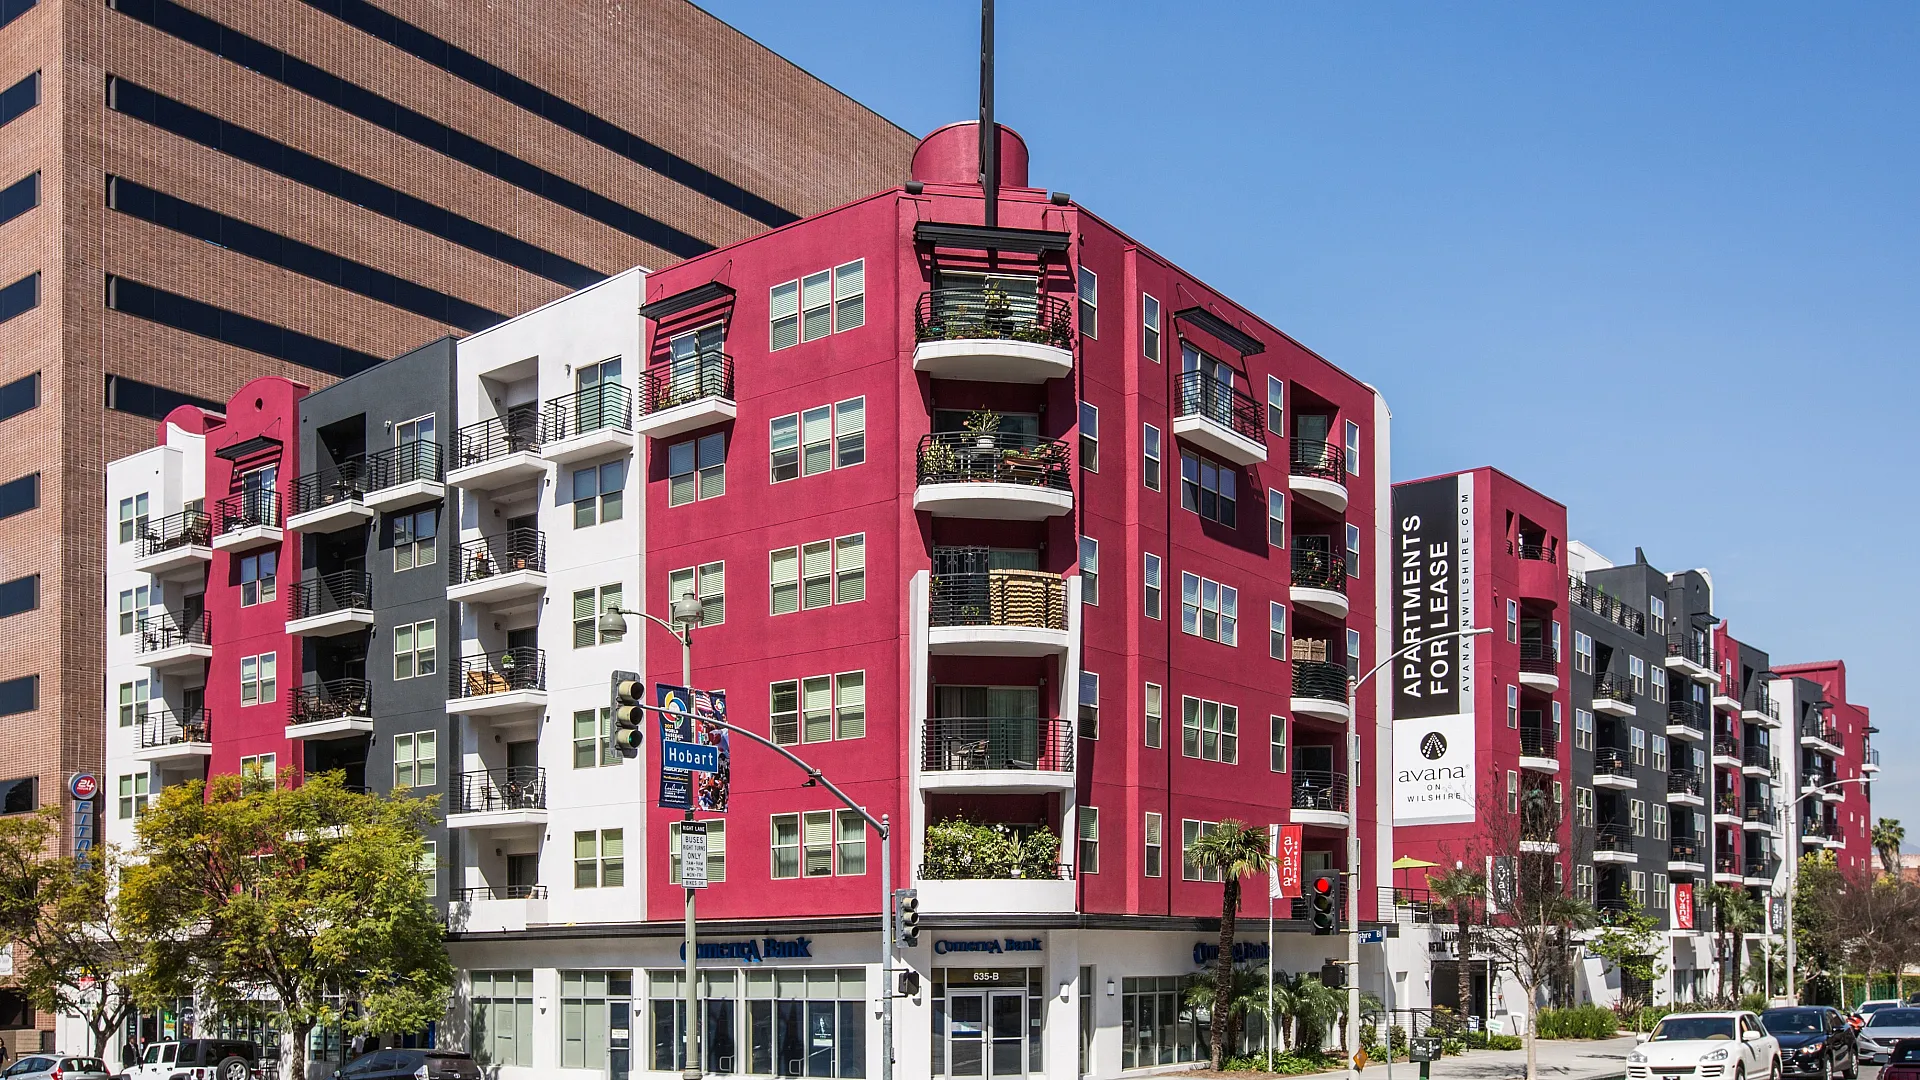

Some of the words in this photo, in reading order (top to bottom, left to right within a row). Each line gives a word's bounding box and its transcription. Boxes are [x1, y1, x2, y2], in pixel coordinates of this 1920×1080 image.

[1429, 541, 1449, 629] LEASE
[1461, 494, 1470, 692] AVANANWILSHIRE.COM
[1402, 515, 1421, 698] APARTMENTS
[1430, 639, 1449, 695] FOR
[668, 747, 714, 766] Hobart
[78, 779, 94, 791] 24
[1426, 784, 1441, 792] ON
[1407, 792, 1461, 803] WILSHIRE
[685, 836, 704, 844] BUSES
[687, 852, 702, 860] ONLY
[1283, 836, 1294, 887] avana
[762, 937, 812, 958] Bank
[1004, 937, 1043, 952] Bank
[973, 972, 1000, 981] 635-B
